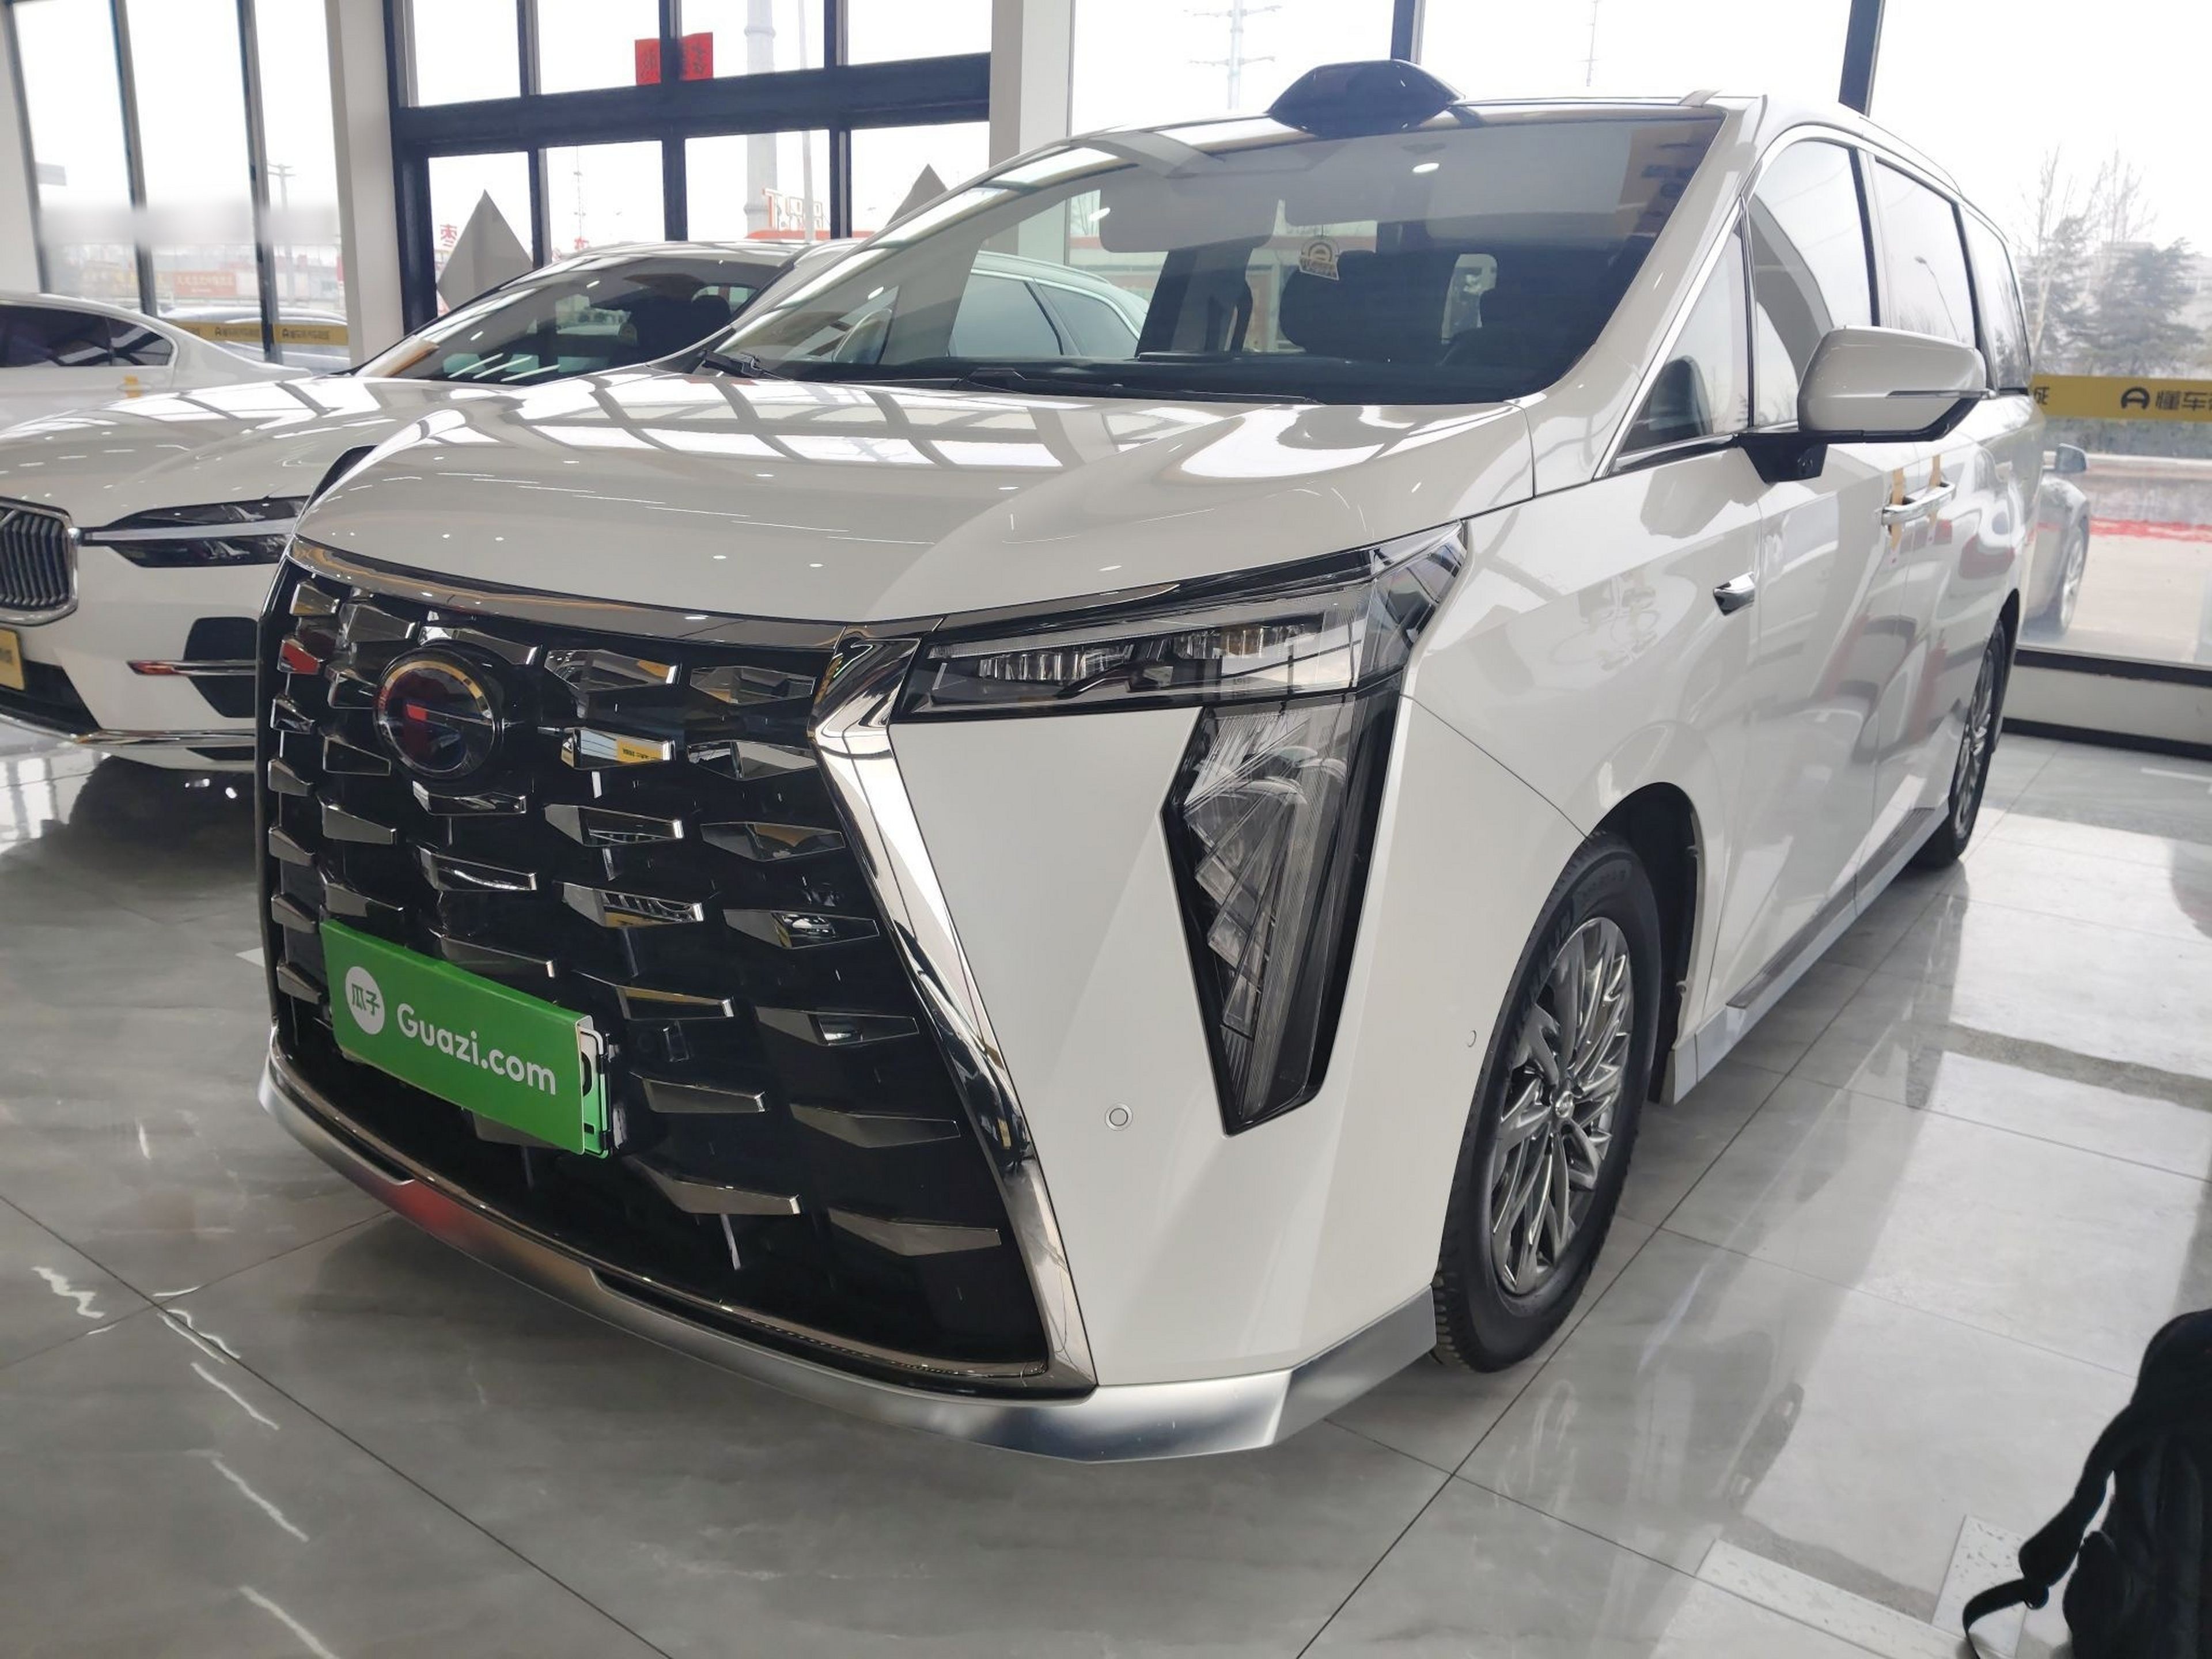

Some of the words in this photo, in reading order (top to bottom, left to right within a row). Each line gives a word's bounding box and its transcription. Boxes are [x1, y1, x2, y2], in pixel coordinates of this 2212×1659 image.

[2155, 391, 2212, 412] 懂车
[351, 983, 381, 1016] 瓜子
[397, 1003, 556, 1096] Guazi.com
